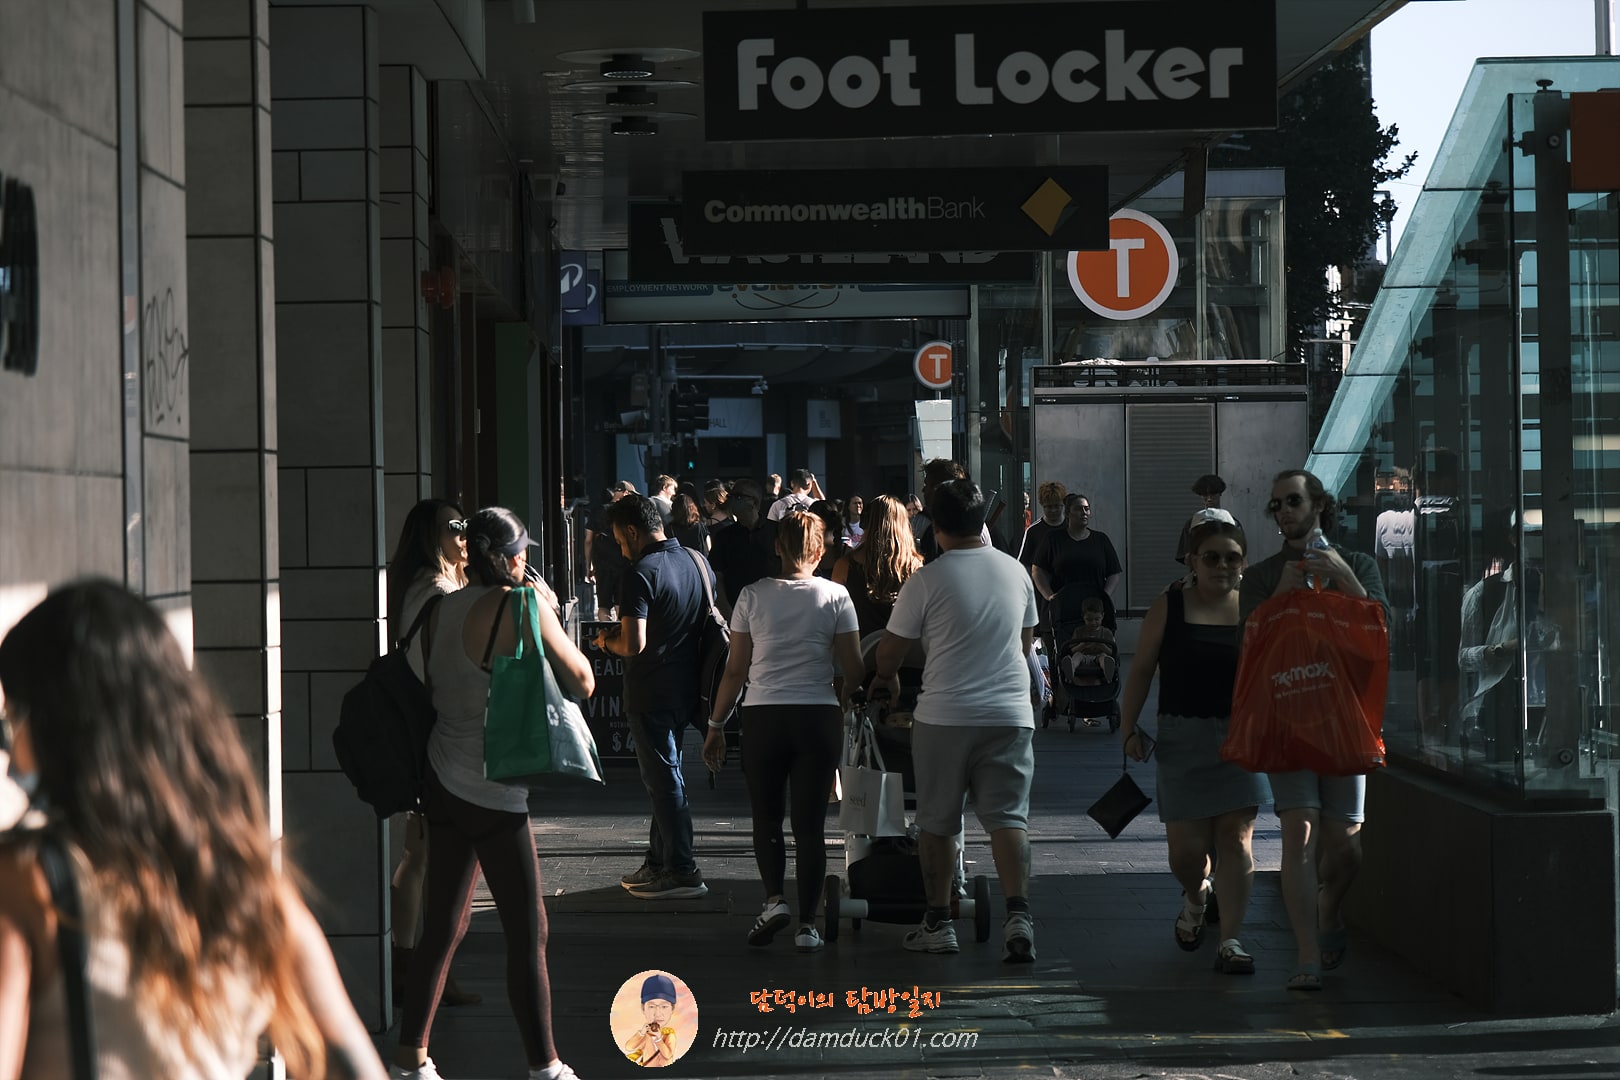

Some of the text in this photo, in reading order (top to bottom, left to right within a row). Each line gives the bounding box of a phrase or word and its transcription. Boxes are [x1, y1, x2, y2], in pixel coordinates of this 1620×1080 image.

[736, 29, 1244, 111] Foot Locker
[703, 196, 987, 223] CommonwealthBank
[1109, 238, 1145, 298] T
[607, 282, 709, 293] EMPLOYMENT NETWORK
[928, 353, 949, 379] T
